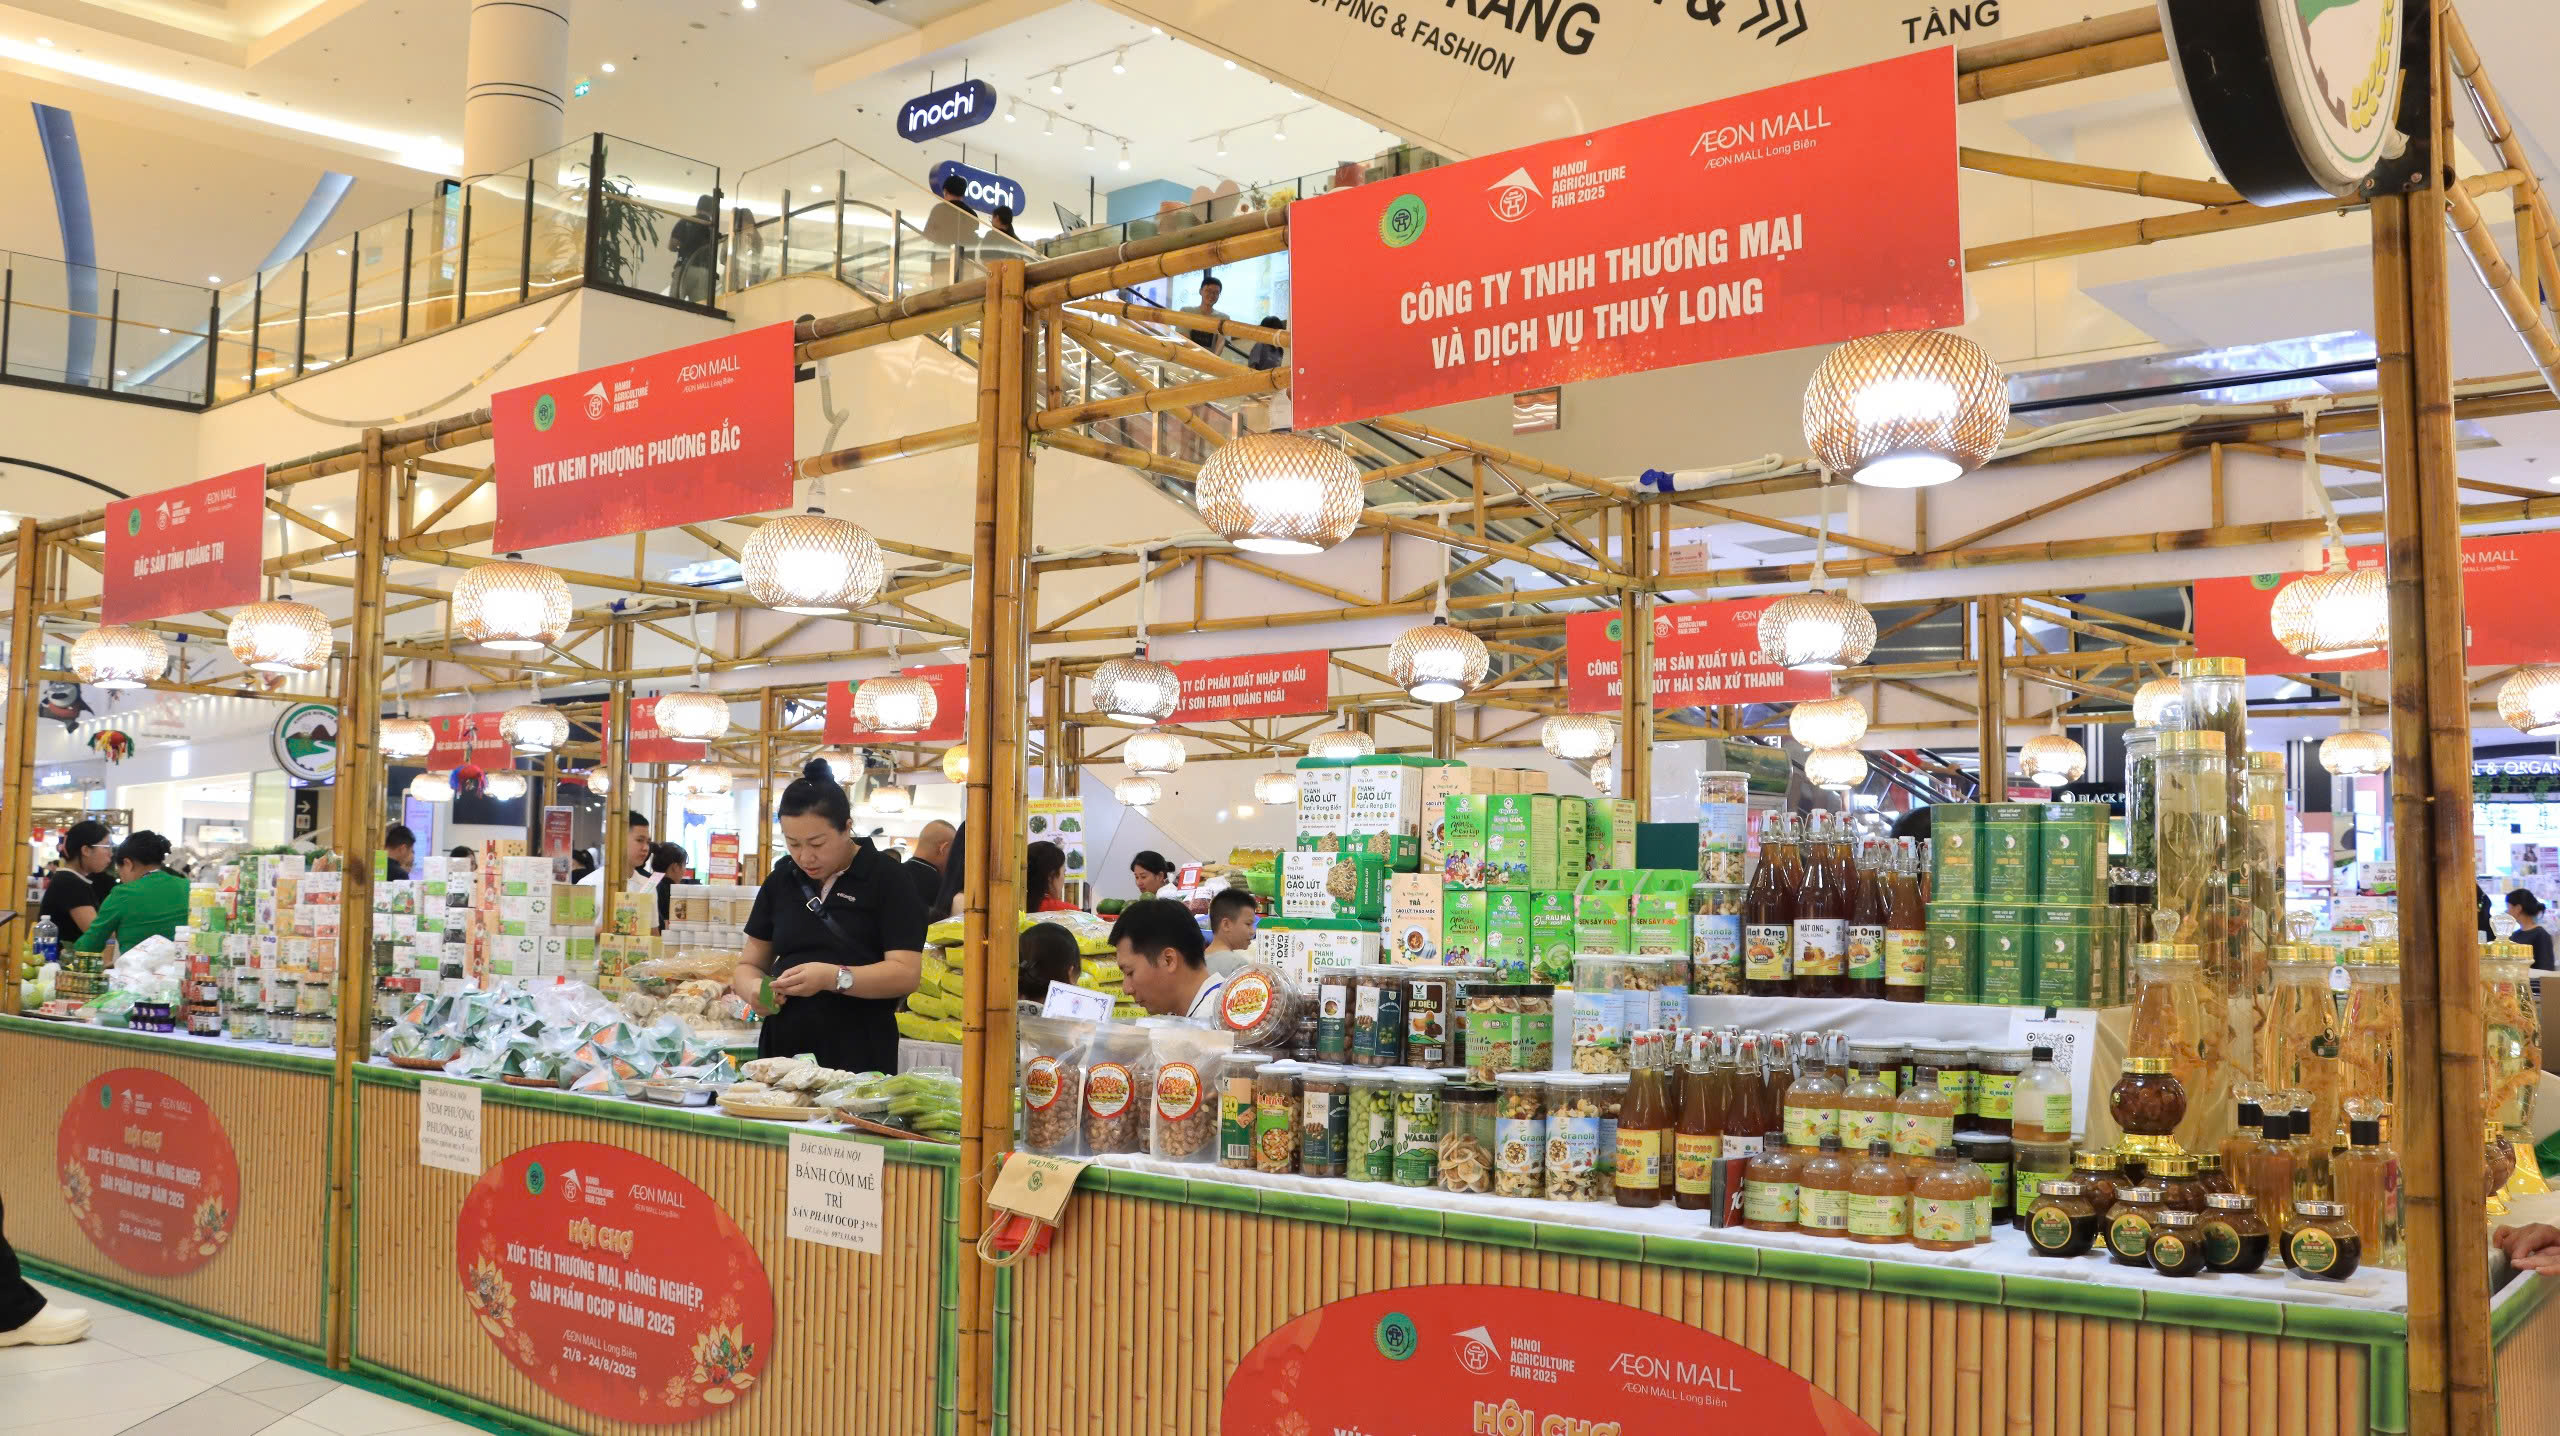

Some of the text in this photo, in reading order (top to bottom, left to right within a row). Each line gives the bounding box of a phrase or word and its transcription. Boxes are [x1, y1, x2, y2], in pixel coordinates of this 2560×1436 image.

[1902, 0, 2000, 44] TẦNG
[1391, 13, 1406, 39] &
[1412, 20, 1516, 79] FASHION
[909, 86, 975, 132] inochi
[1761, 105, 1831, 140] MALL
[1734, 150, 1764, 164] MALL
[1766, 144, 1791, 159] Long
[1793, 137, 1816, 151] Biên
[1552, 159, 1587, 180] HANOI
[1552, 165, 1626, 195] AGRICULTURE
[1552, 186, 1605, 209] FAIR 2025
[1400, 214, 1803, 325] CÔNG TY TNHH THƯƠNG MẠI
[1431, 278, 1763, 369] VÀ DỊCH VỤ THUÝ LONG
[709, 355, 740, 375] MALL
[614, 386, 648, 403] AGRICULTURE
[534, 418, 740, 488] HTX NEM PHƯỢNG PHƯƠNG BẮC
[134, 541, 224, 580] ĐẶC SẢN TỈNH QUẢNG TRỊ
[2479, 550, 2519, 563] MALL
[1677, 620, 1708, 628] AGRICULTURE
[1588, 648, 1746, 676] CÔNG SẢN XUẤT VÀ
[1183, 664, 1306, 692] TY CỔ PHẦN XUẤT NHẬP KHẨU
[1674, 671, 1784, 692] HẢI SẢN XỨ THANH
[1176, 688, 1285, 711] LÝ SƠN FARM QUẢNG NGÃI
[2486, 762, 2497, 775] &
[1303, 794, 1337, 805] GẠO LỨT
[1357, 792, 1392, 803] GẠO LỨT
[2078, 793, 2117, 803] BLACK
[1286, 880, 1321, 891] GẠO LỨT
[1560, 912, 1571, 921] MÁ
[1764, 928, 1785, 938] Ong
[1812, 924, 1824, 932] ONG
[1860, 928, 1881, 938] Ong
[1336, 956, 1352, 966] LỨT
[426, 1101, 442, 1115] NEM
[1561, 1132, 1595, 1140] Granola
[847, 1150, 861, 1162] NỘI
[796, 1162, 826, 1181] BÁNH
[585, 1185, 615, 1199] AGRICULTURE
[657, 1188, 686, 1209] MALL
[835, 1216, 858, 1229] OCOP
[568, 1216, 634, 1261] HỘI CHỢ
[506, 1241, 704, 1313] XÚC TIẾN THƯƠNG MẠI, NÔNG NGHIỆP,
[530, 1275, 675, 1337] SẢN PHẨM OCOP NĂM 2025
[583, 1333, 602, 1350] MALL
[603, 1337, 620, 1356] Long
[621, 1344, 637, 1360] Biên
[1510, 1336, 1541, 1353] HANOI
[562, 1346, 636, 1379] 21/8 24/8/2025
[1510, 1351, 1575, 1373] AGRICULTURE
[1510, 1364, 1557, 1384] FAIR 2025
[1677, 1362, 1742, 1392] MALL
[1650, 1386, 1728, 1408] MALL Long Biên
